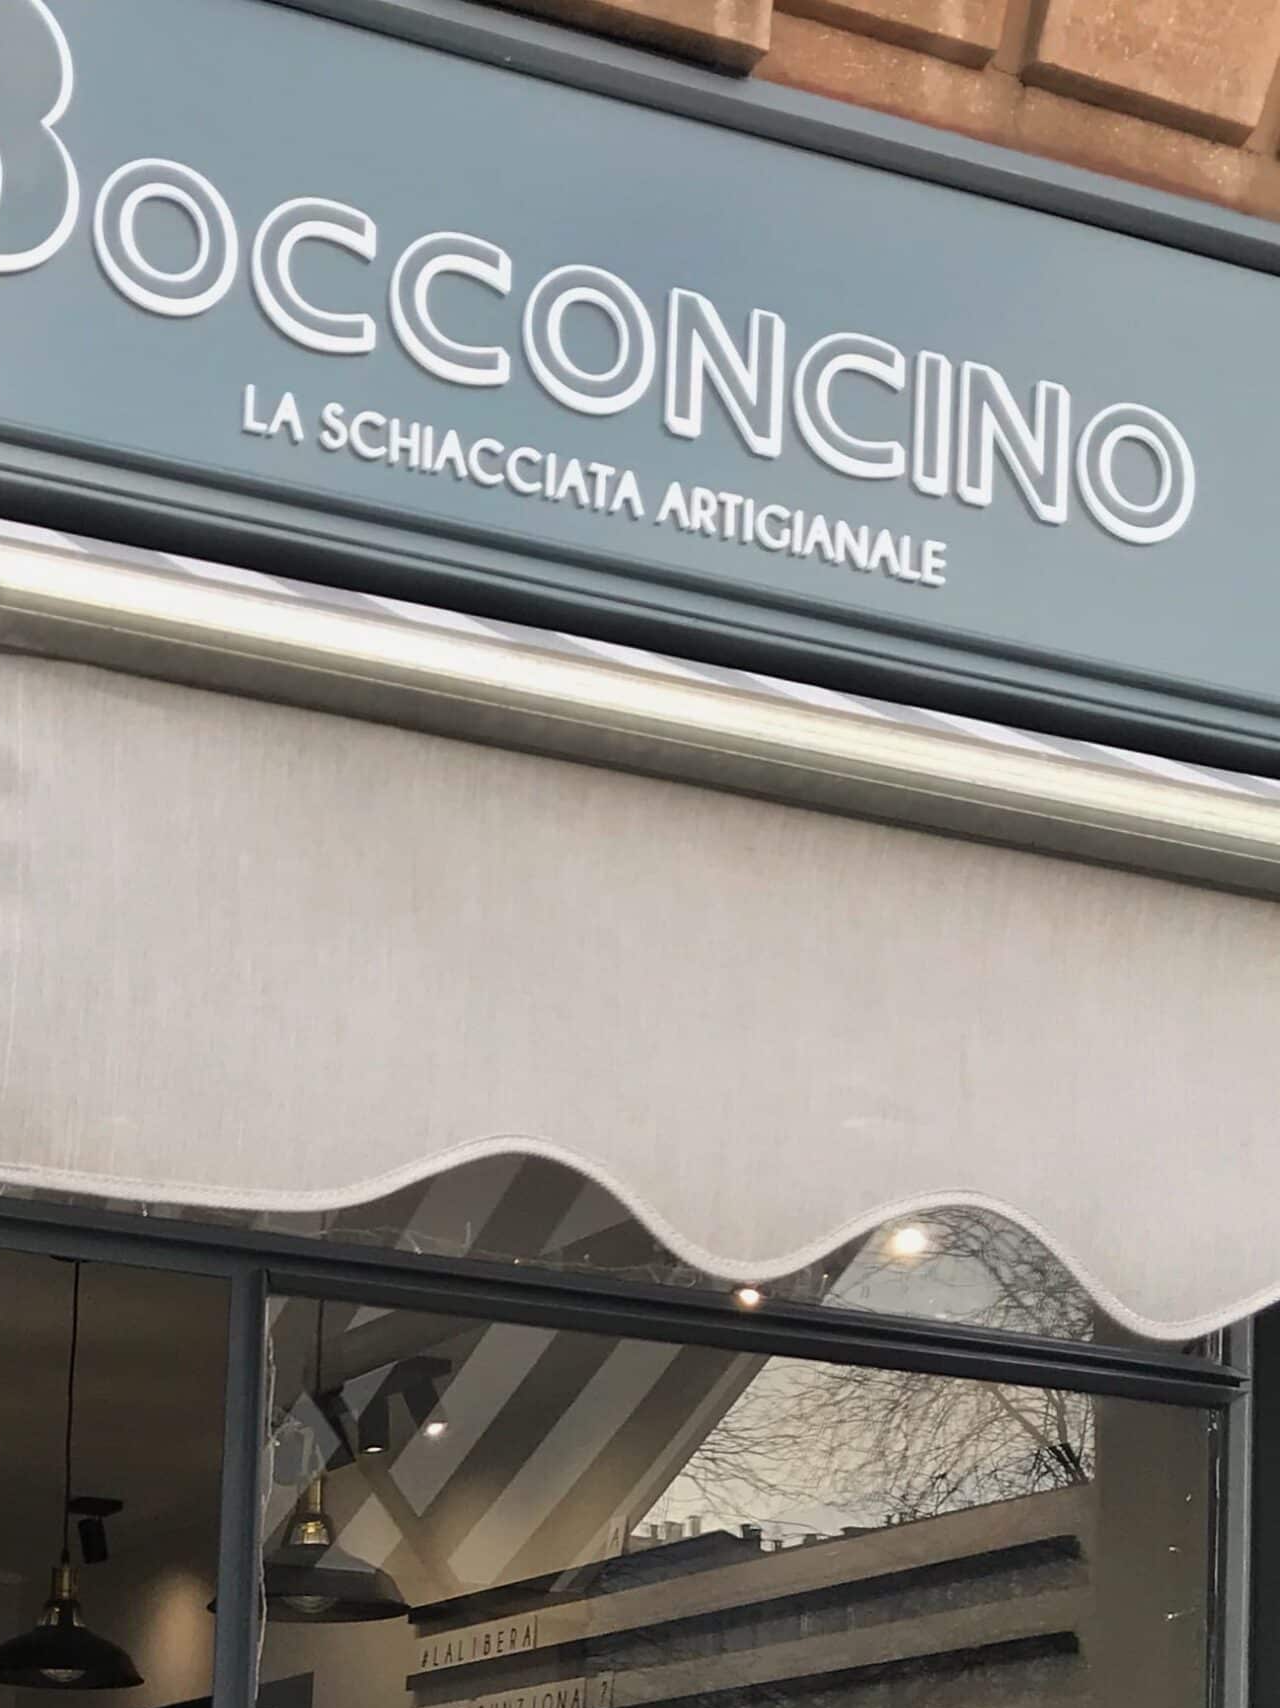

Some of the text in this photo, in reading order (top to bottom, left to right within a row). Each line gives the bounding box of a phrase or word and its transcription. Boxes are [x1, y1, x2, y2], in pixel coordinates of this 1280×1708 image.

[242, 384, 948, 588] LA SCHIACCIATA ARTIGIANALE
[421, 1624, 532, 1668] #LALIBERA
